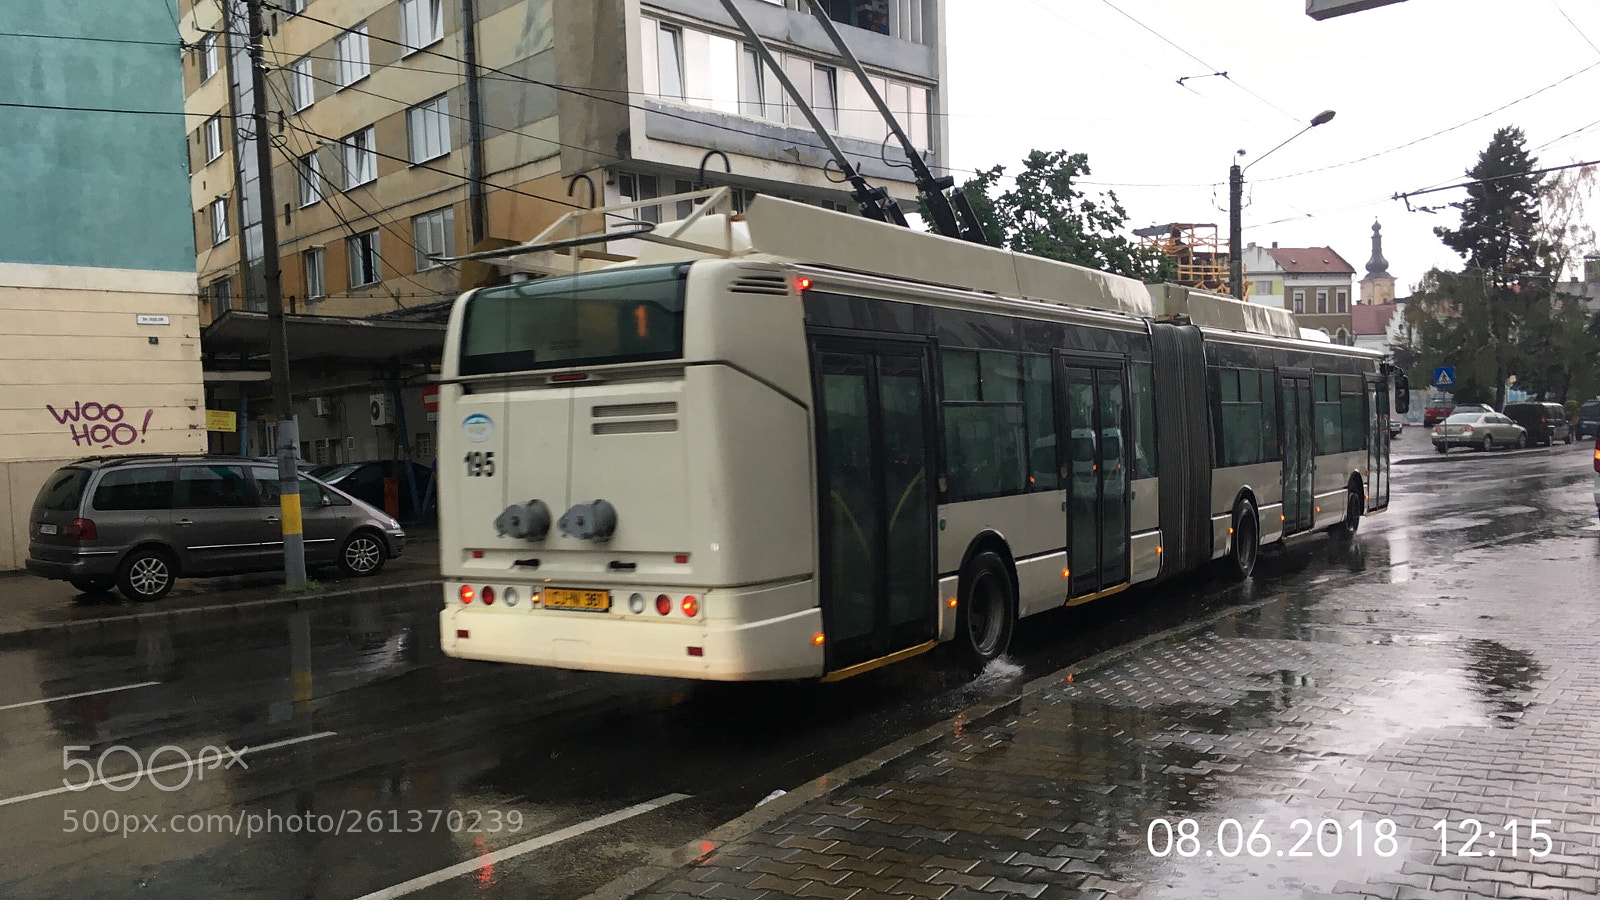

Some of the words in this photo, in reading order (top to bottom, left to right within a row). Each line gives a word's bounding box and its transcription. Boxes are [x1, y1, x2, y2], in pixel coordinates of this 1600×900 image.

[46, 400, 124, 425] WOO
[69, 408, 154, 447] HOO!
[464, 451, 495, 477] 195
